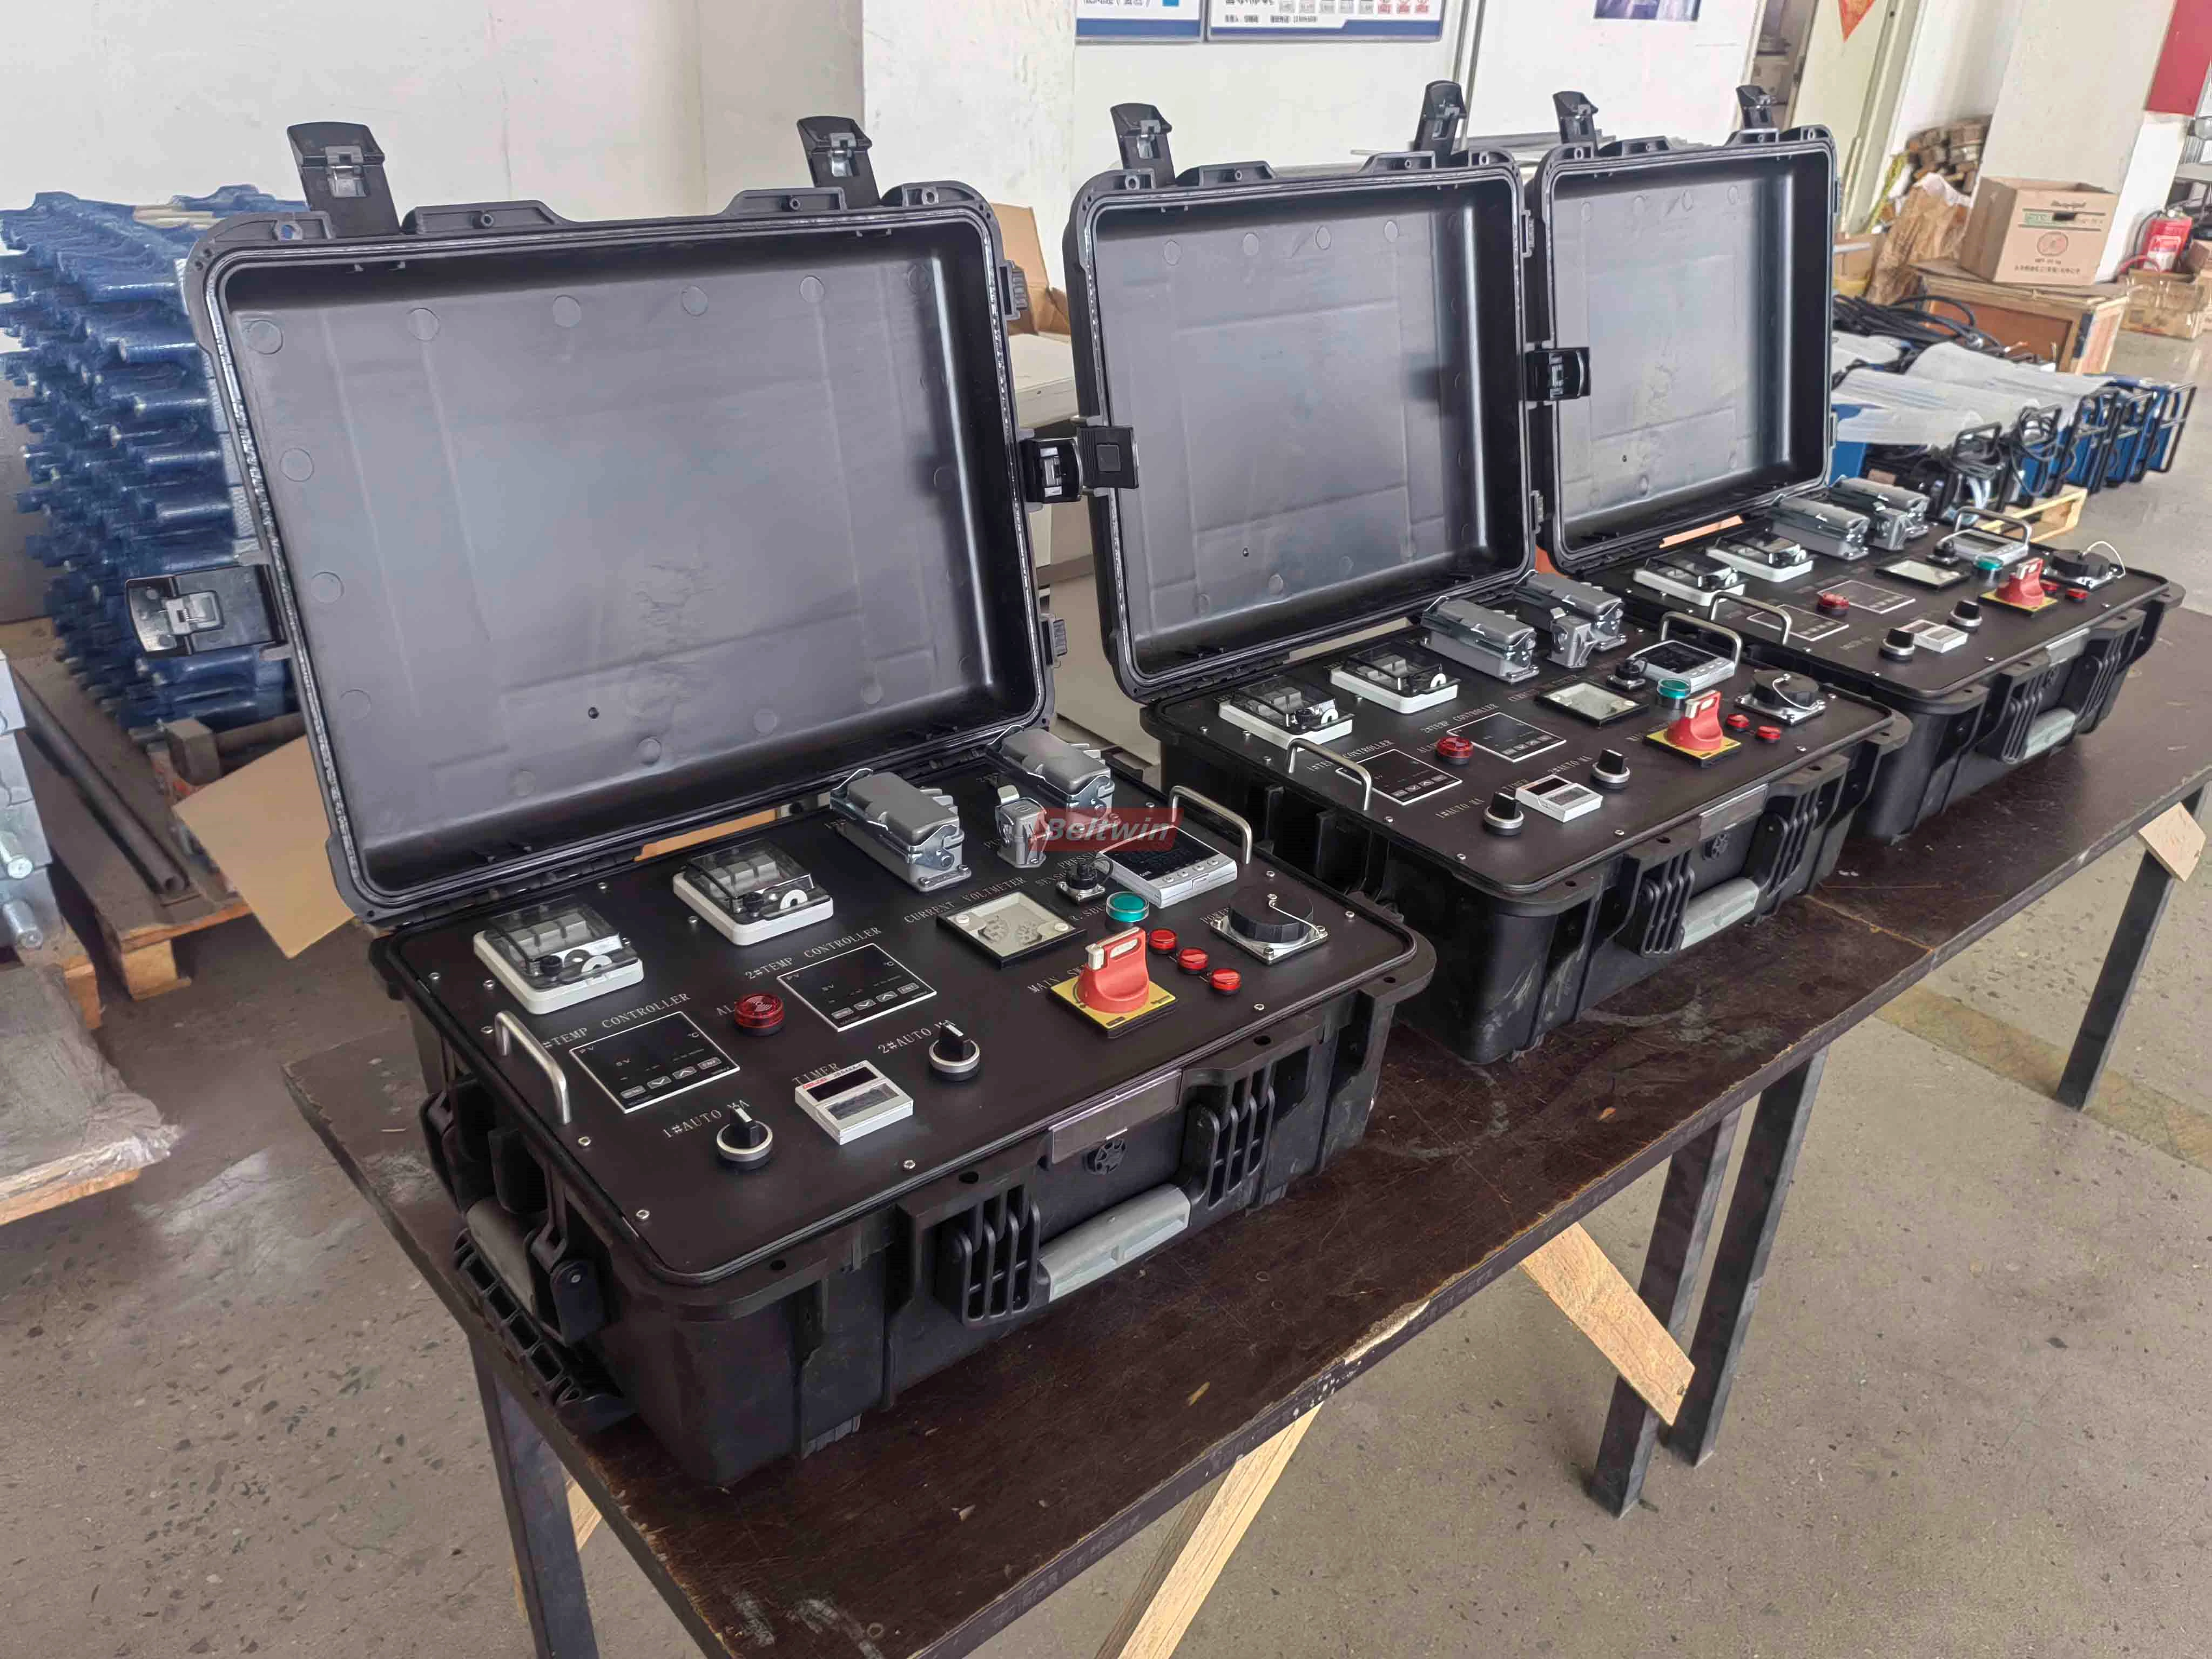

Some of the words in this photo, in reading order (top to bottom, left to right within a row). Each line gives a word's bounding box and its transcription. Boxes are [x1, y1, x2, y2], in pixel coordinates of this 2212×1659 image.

[1343, 739, 1397, 759] CONTROLLER
[903, 901, 956, 923] CURRENT
[961, 876, 1028, 902] VOLTMETER
[745, 957, 794, 980] 2#TEMP
[804, 927, 882, 958] CONTROLLER
[542, 1028, 588, 1048] #TEMP
[601, 993, 691, 1028] CONTROLLER
[878, 1027, 932, 1054] 2#AUTO
[792, 1063, 840, 1085] TIMER
[662, 1109, 722, 1138] 1#AUTO
